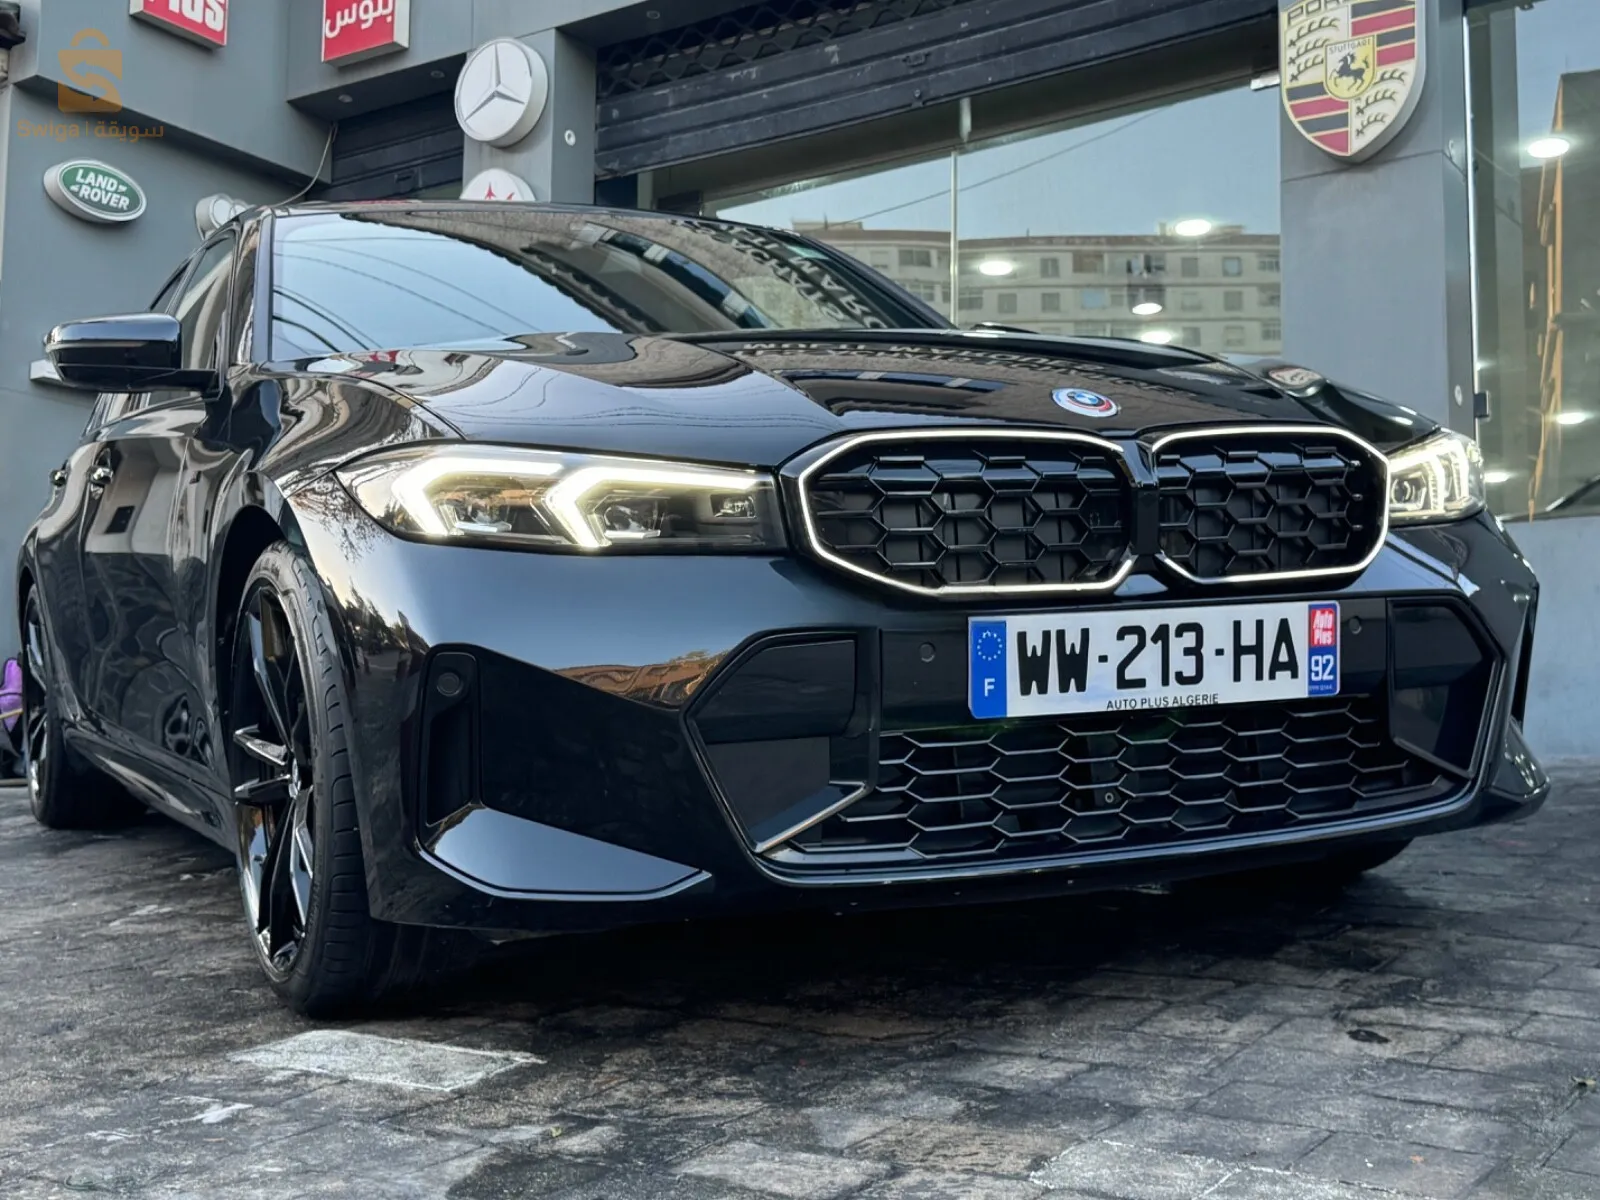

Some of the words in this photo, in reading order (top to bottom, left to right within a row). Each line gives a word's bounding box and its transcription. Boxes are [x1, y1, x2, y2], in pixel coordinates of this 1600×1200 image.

[75, 168, 118, 193] LAND
[79, 184, 130, 211] ROVER
[1311, 654, 1334, 682] 92
[984, 677, 996, 697] F
[1106, 698, 1137, 711] AUTO
[1141, 696, 1169, 709] PLUS
[1172, 693, 1219, 706] ALGERIE
